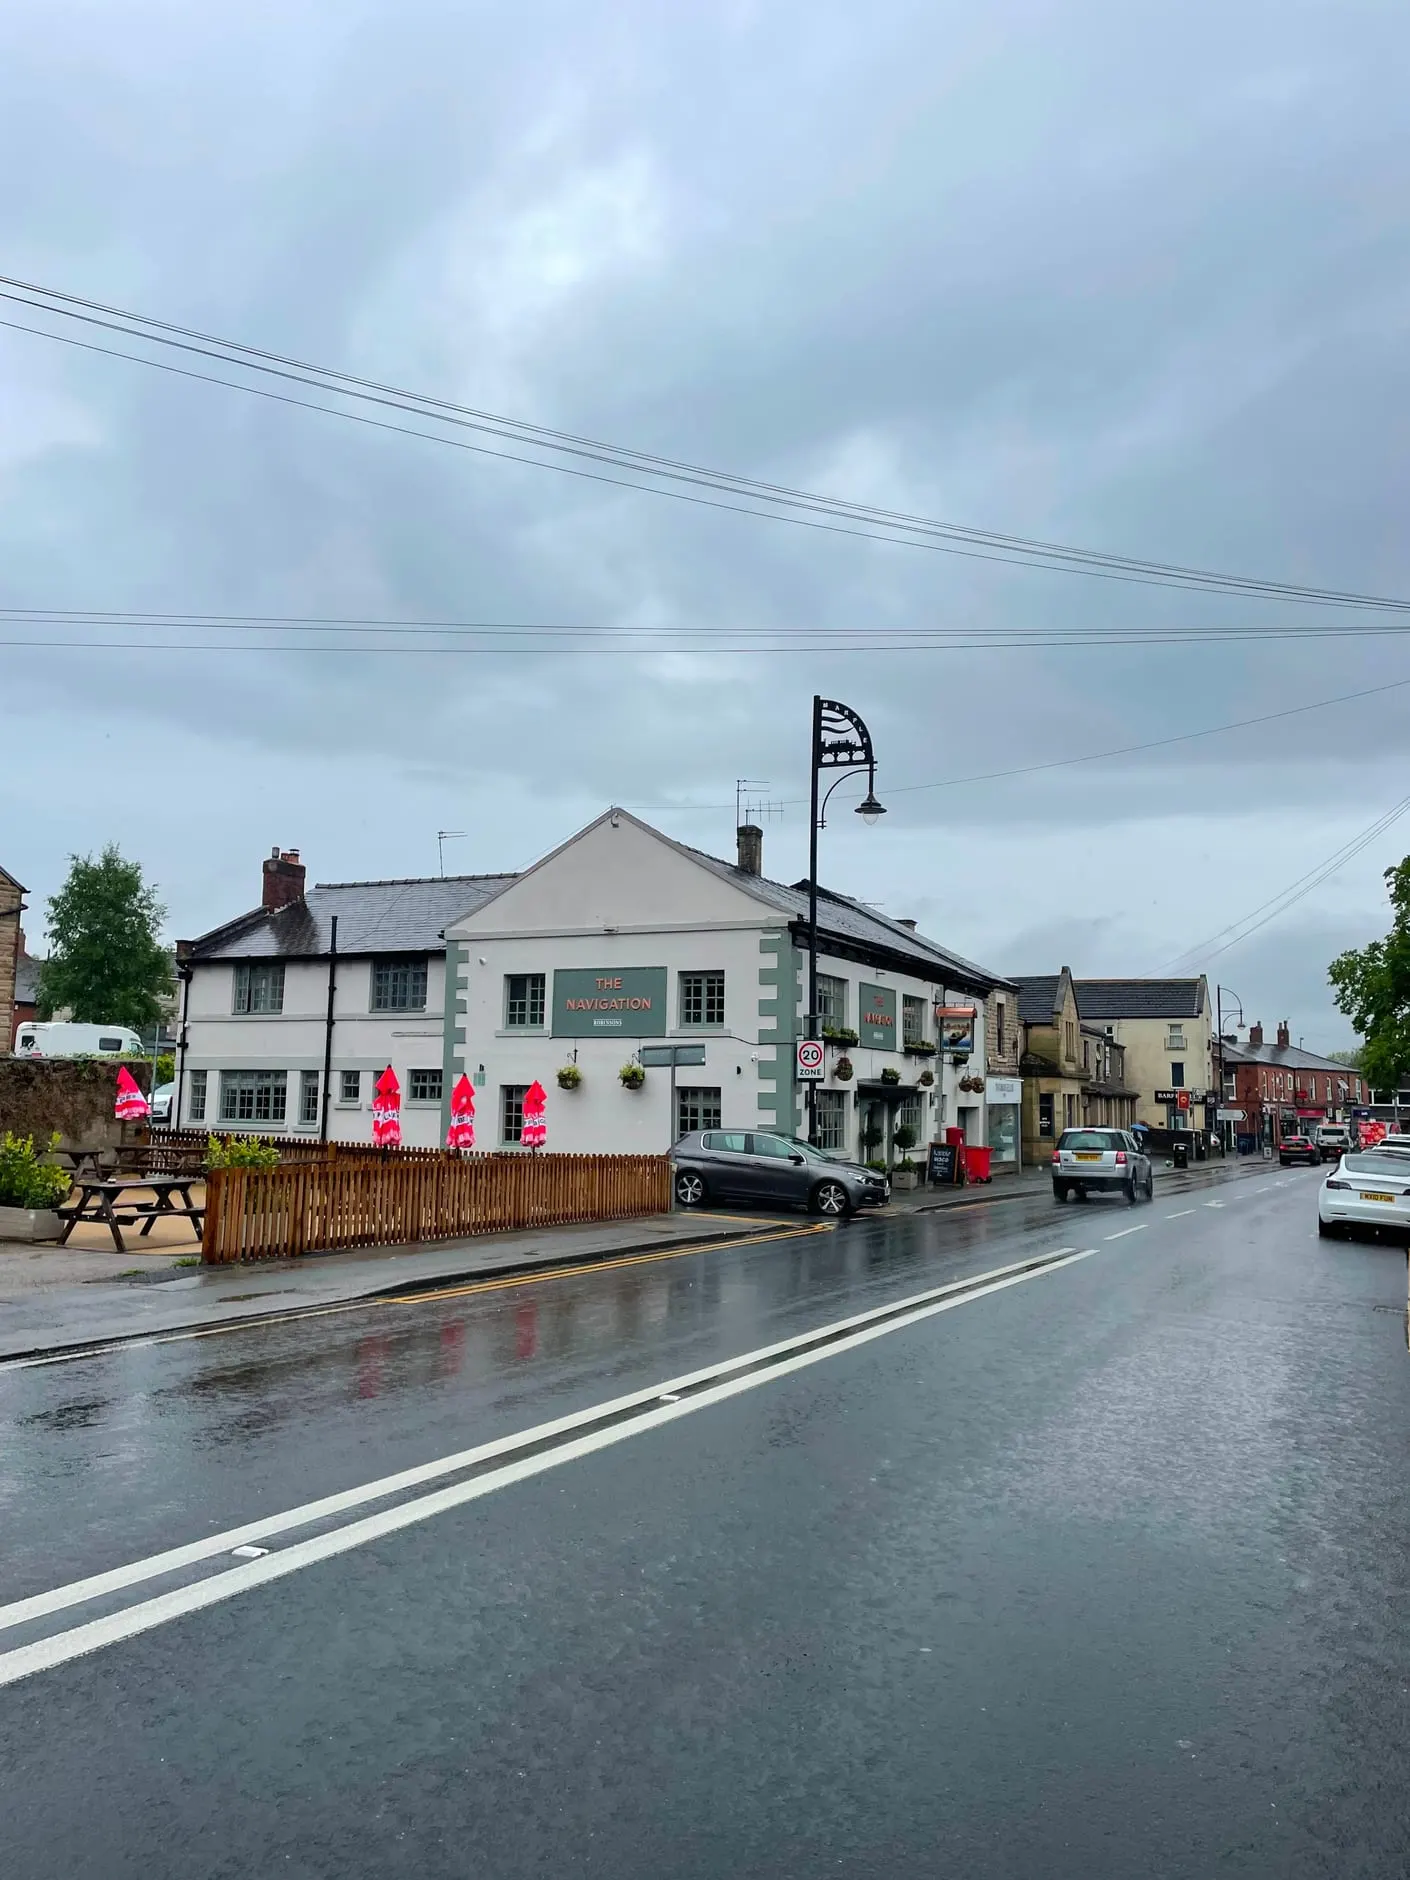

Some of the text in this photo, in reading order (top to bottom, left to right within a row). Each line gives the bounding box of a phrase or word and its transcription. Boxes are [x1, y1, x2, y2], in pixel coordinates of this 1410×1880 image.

[823, 702, 868, 744] MARPLE
[596, 977, 623, 990] THE
[566, 998, 652, 1011] NAVIGATION
[802, 1050, 819, 1060] 20
